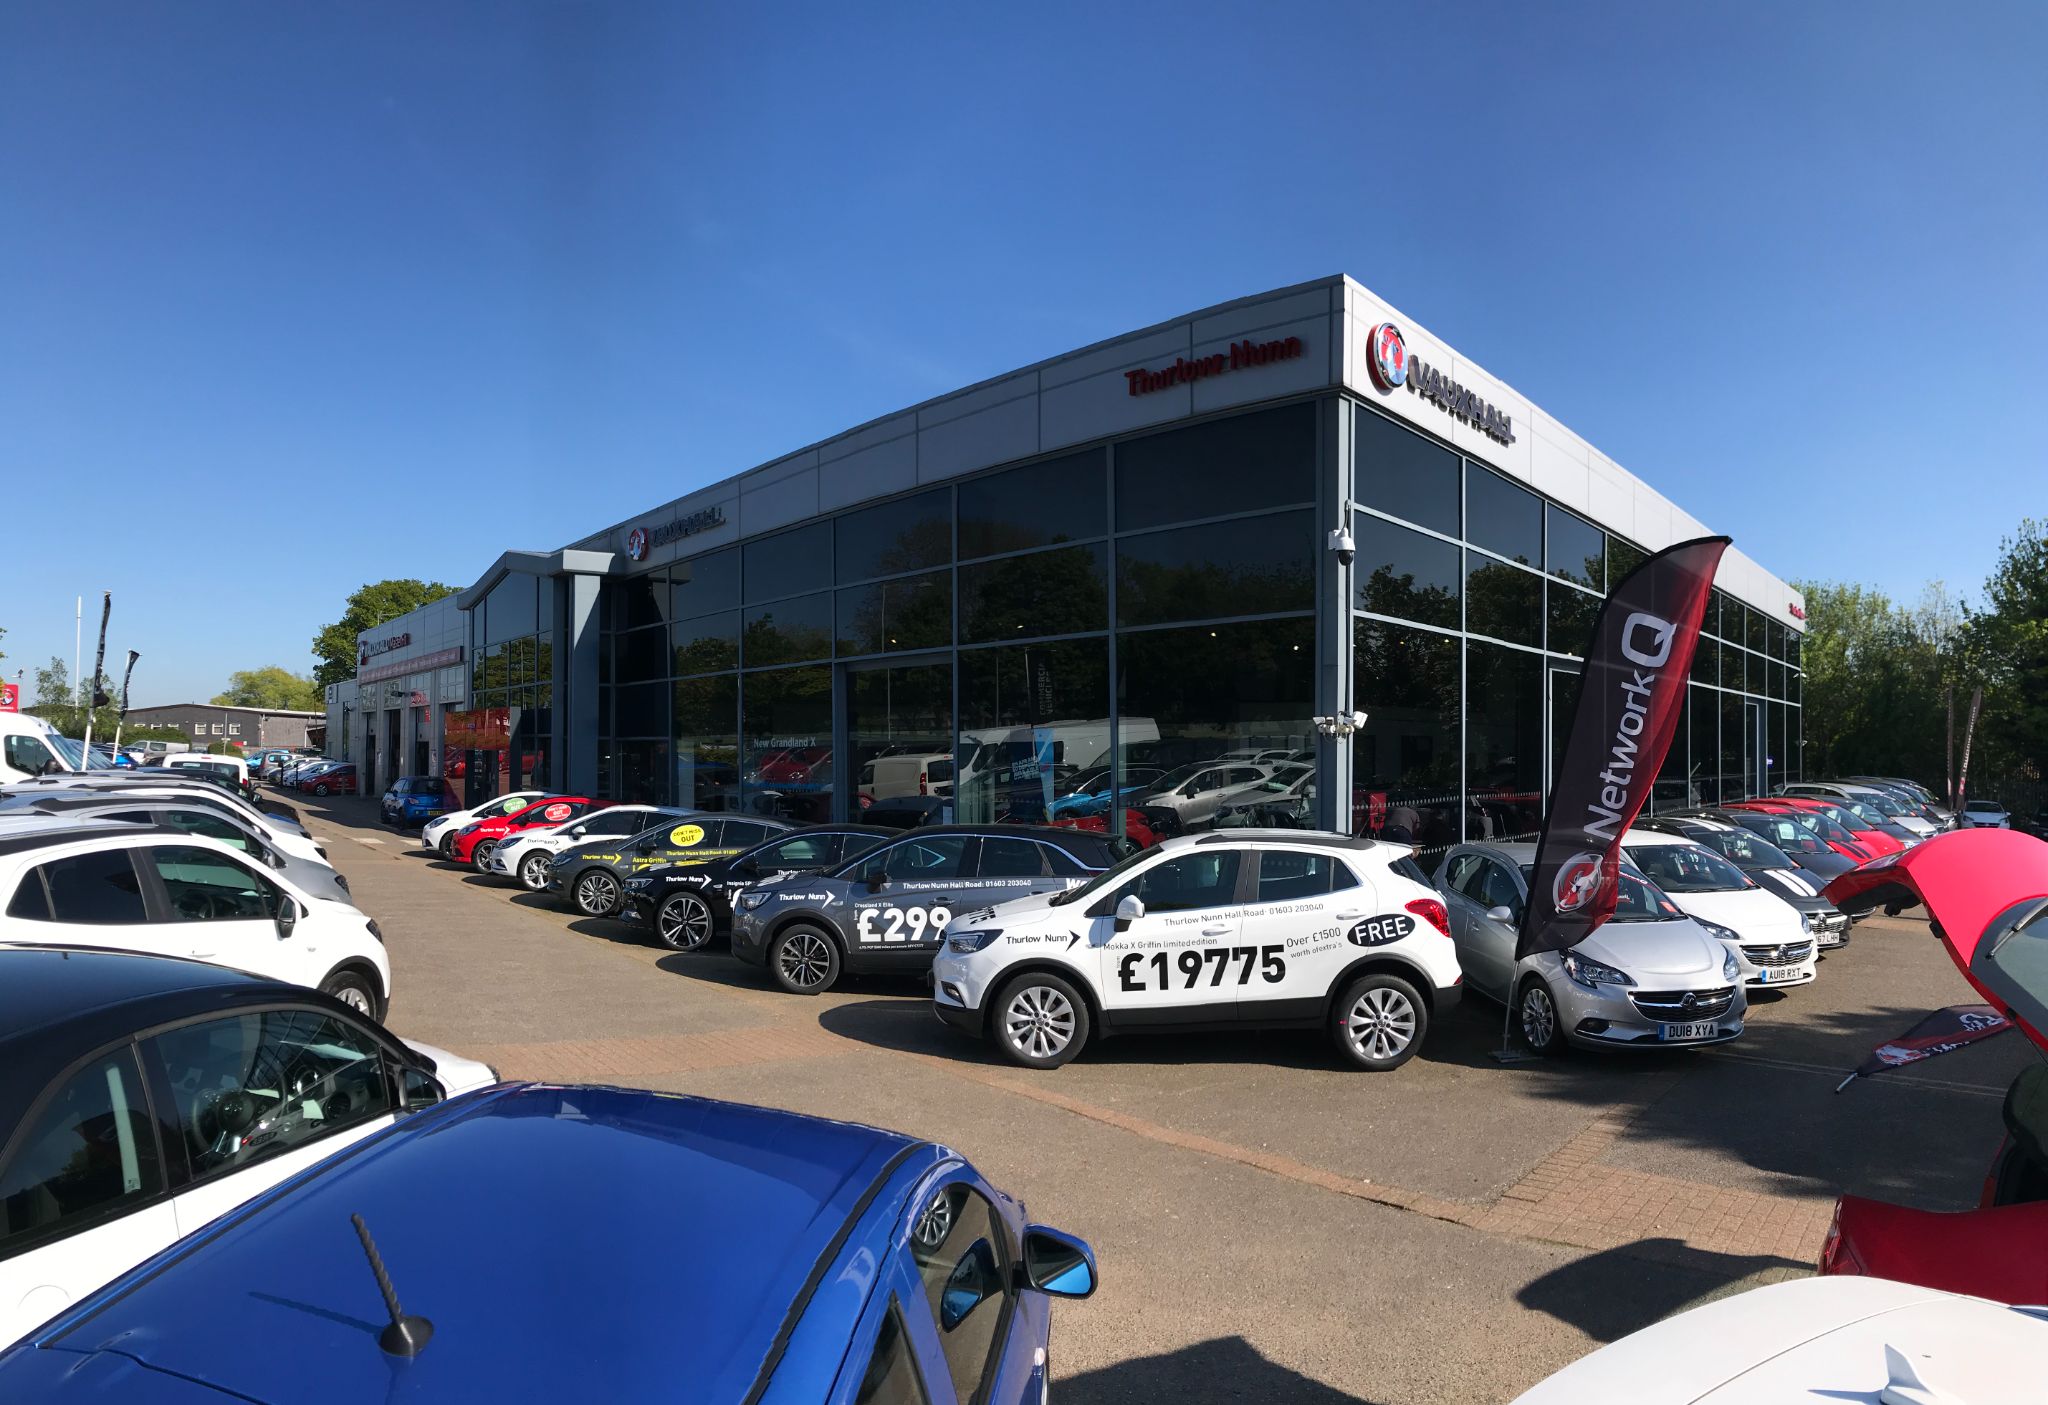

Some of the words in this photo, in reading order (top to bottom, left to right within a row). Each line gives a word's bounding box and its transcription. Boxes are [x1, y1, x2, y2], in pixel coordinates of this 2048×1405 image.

[1124, 353, 1226, 396] Thurlow
[1229, 336, 1301, 370] Nunn
[1408, 354, 1516, 444] VAUXHALL
[753, 738, 769, 748] New
[771, 737, 808, 748] Grandland
[810, 736, 816, 747] X
[1007, 879, 1032, 887] 203040
[779, 893, 805, 901] Thurlow
[1164, 917, 1199, 927] Thurlow
[1201, 914, 1223, 923] Nunn
[1224, 911, 1242, 920] Hall
[1269, 906, 1293, 915] 01603
[1295, 903, 1324, 912] 203040
[857, 906, 952, 943] £299
[1354, 916, 1409, 945] FREE
[1006, 935, 1041, 944] Thurlow
[1044, 934, 1068, 942] Nunn
[1103, 941, 1128, 950] Mokka
[1130, 941, 1136, 949] X
[1137, 940, 1162, 949] Griffin
[1163, 938, 1191, 948] limited
[1191, 937, 1218, 946] edition
[1286, 936, 1310, 948] Over
[1312, 927, 1341, 942] £1500
[1290, 948, 1311, 959] worth
[1117, 944, 1286, 992] £19775
[1769, 969, 1785, 980] AU18
[1787, 967, 1801, 978] RXT
[1668, 1025, 1693, 1038] DU18
[1694, 1024, 1714, 1036] XYA
